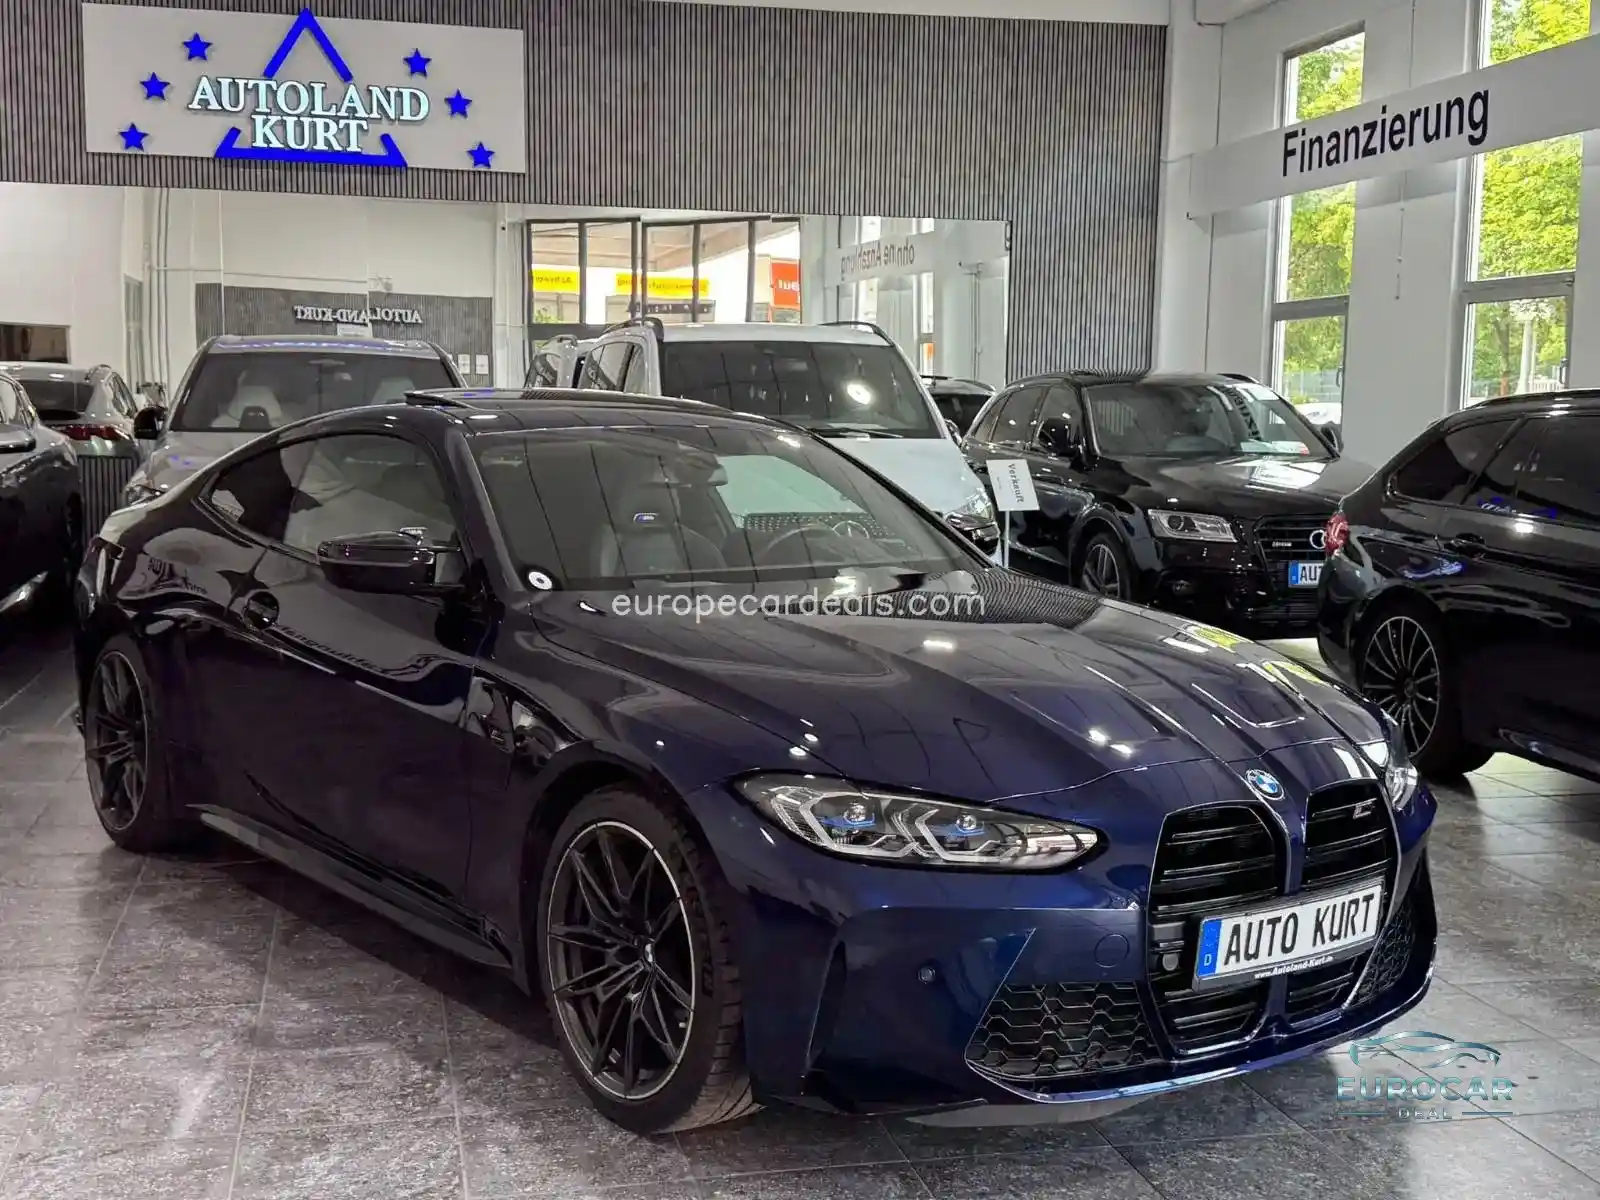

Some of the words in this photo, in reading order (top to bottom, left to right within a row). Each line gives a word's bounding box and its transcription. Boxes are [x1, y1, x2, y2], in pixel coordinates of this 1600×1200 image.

[188, 76, 430, 120] AUTOLAND
[250, 113, 369, 153] KURT
[1282, 88, 1490, 177] Finanzierung
[1007, 464, 1024, 503] Verkauft
[1224, 912, 1299, 965] AUTO
[1312, 893, 1375, 948] KURT
